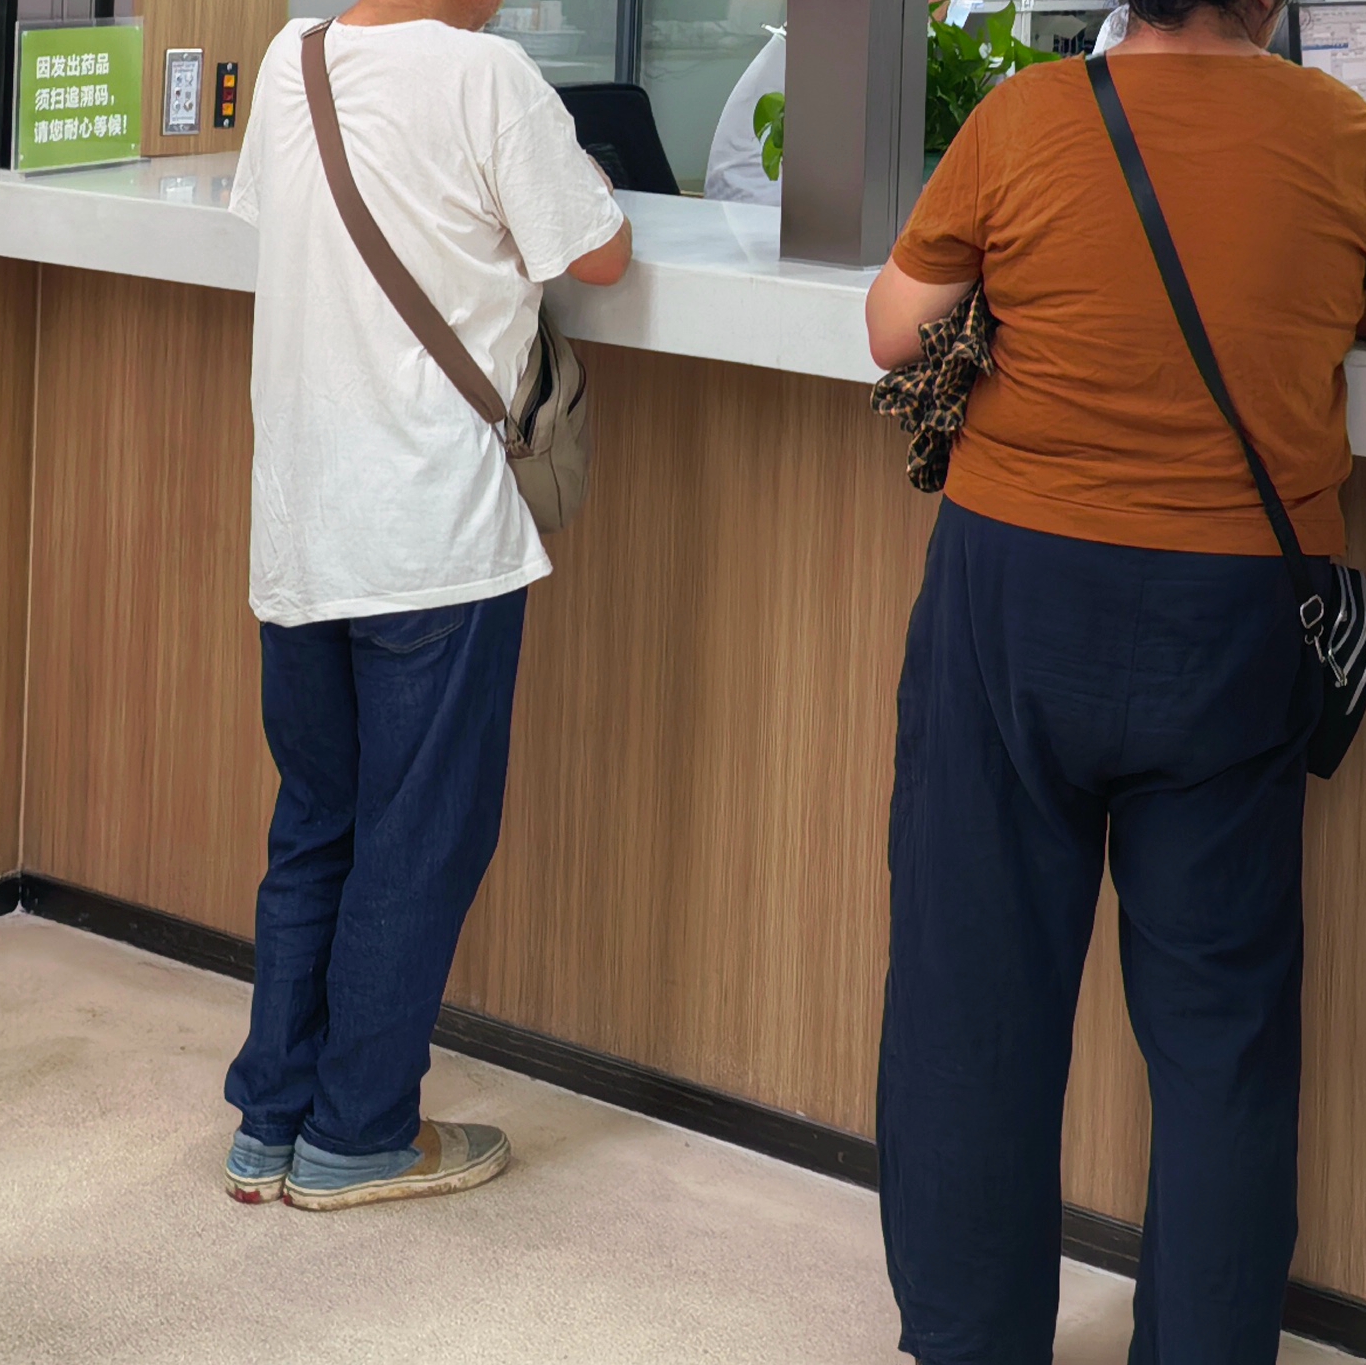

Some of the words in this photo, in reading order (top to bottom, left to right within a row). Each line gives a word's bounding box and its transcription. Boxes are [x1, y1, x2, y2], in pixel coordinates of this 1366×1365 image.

[36, 53, 110, 80] 因发出药品
